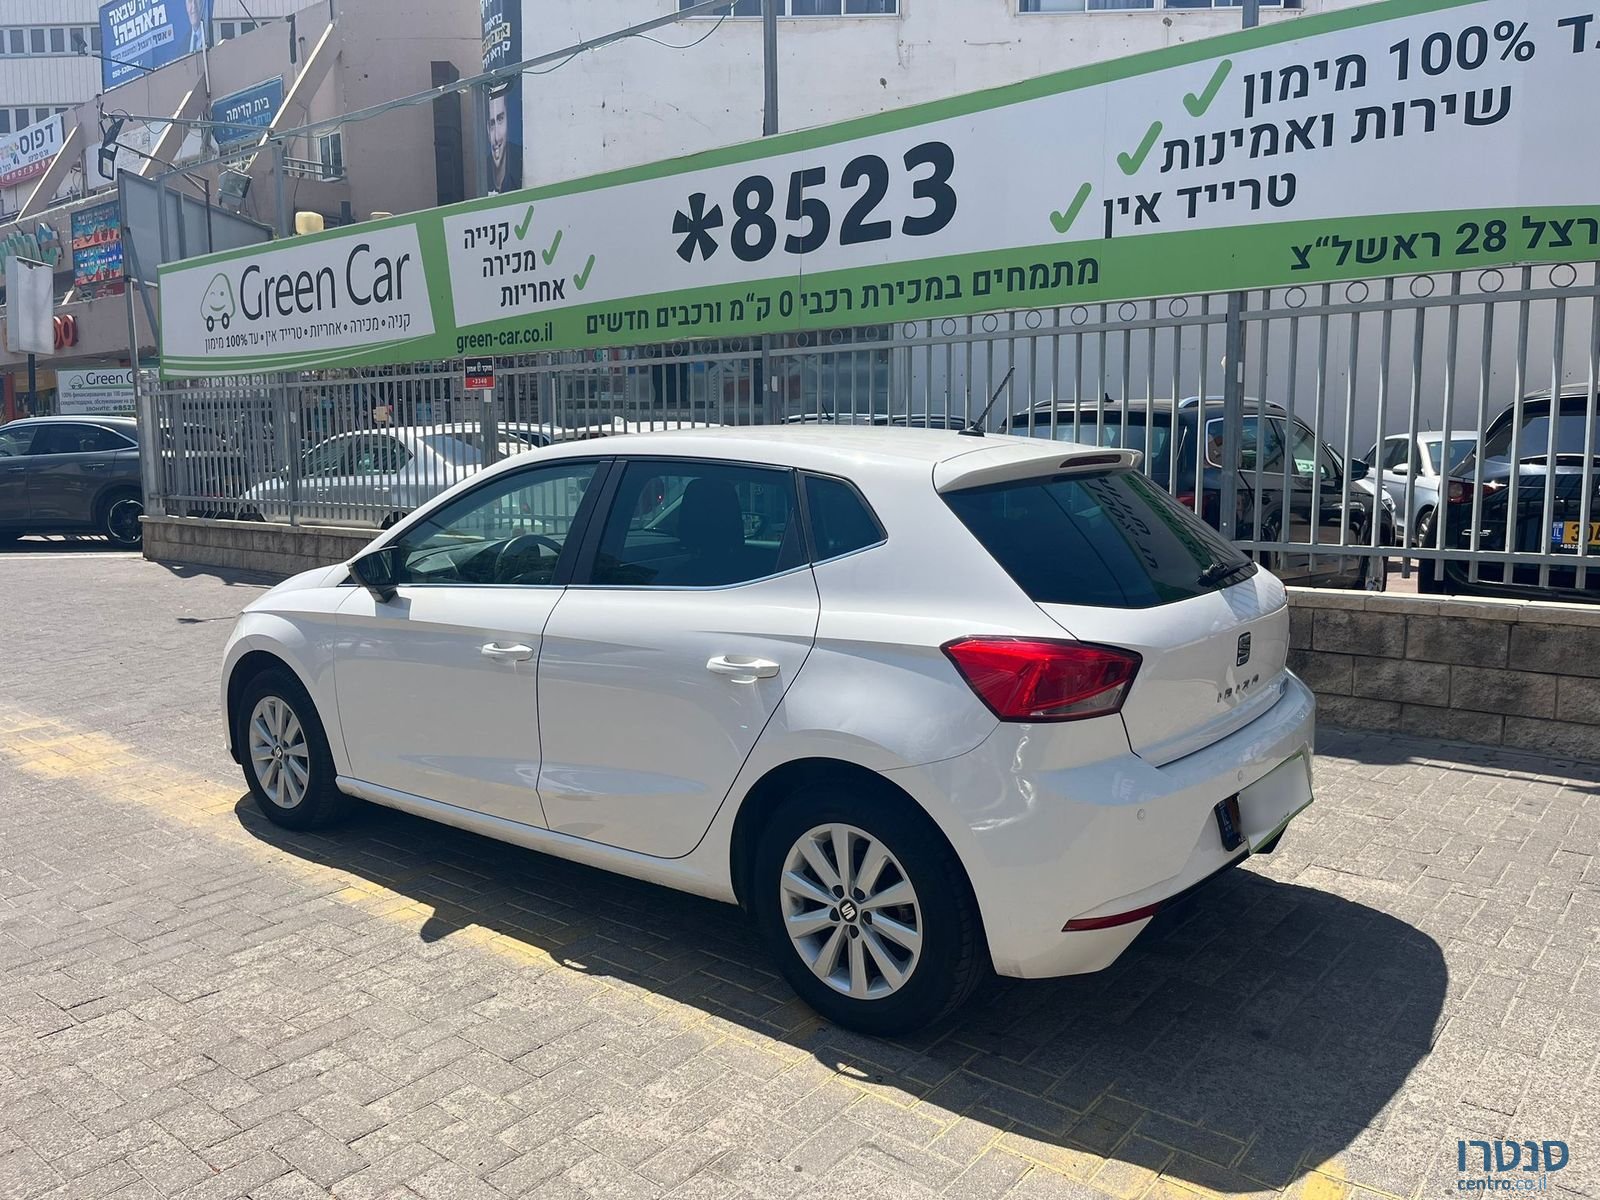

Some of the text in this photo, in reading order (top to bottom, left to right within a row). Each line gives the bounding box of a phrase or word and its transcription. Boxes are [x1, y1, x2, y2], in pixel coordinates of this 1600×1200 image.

[112, 4, 167, 46] מאהבה!
[1243, 13, 1600, 118] ד 100% מימון
[226, 97, 270, 121] בית קדימה
[19, 123, 54, 155] דפוס
[1160, 86, 1512, 173] שירות ואמינות
[1103, 172, 1297, 239] טרייד אין
[464, 222, 509, 250] קנייה
[1455, 220, 1508, 255] 28
[1522, 215, 1600, 249] רצל
[483, 250, 536, 278] מכירה
[972, 258, 1099, 296] מתמחים
[240, 244, 410, 321] Green Car
[500, 279, 565, 307] אחריות
[861, 274, 963, 309] במכירת
[656, 302, 721, 328] ורכבים
[779, 290, 793, 317] 0
[801, 288, 853, 314] רכבי
[205, 313, 411, 353] קניה מכירה אחריות טרייד אין עד 100% מימון
[456, 322, 553, 353] green-car.co.il
[586, 309, 649, 334] חדשים
[86, 372, 123, 385] Green
